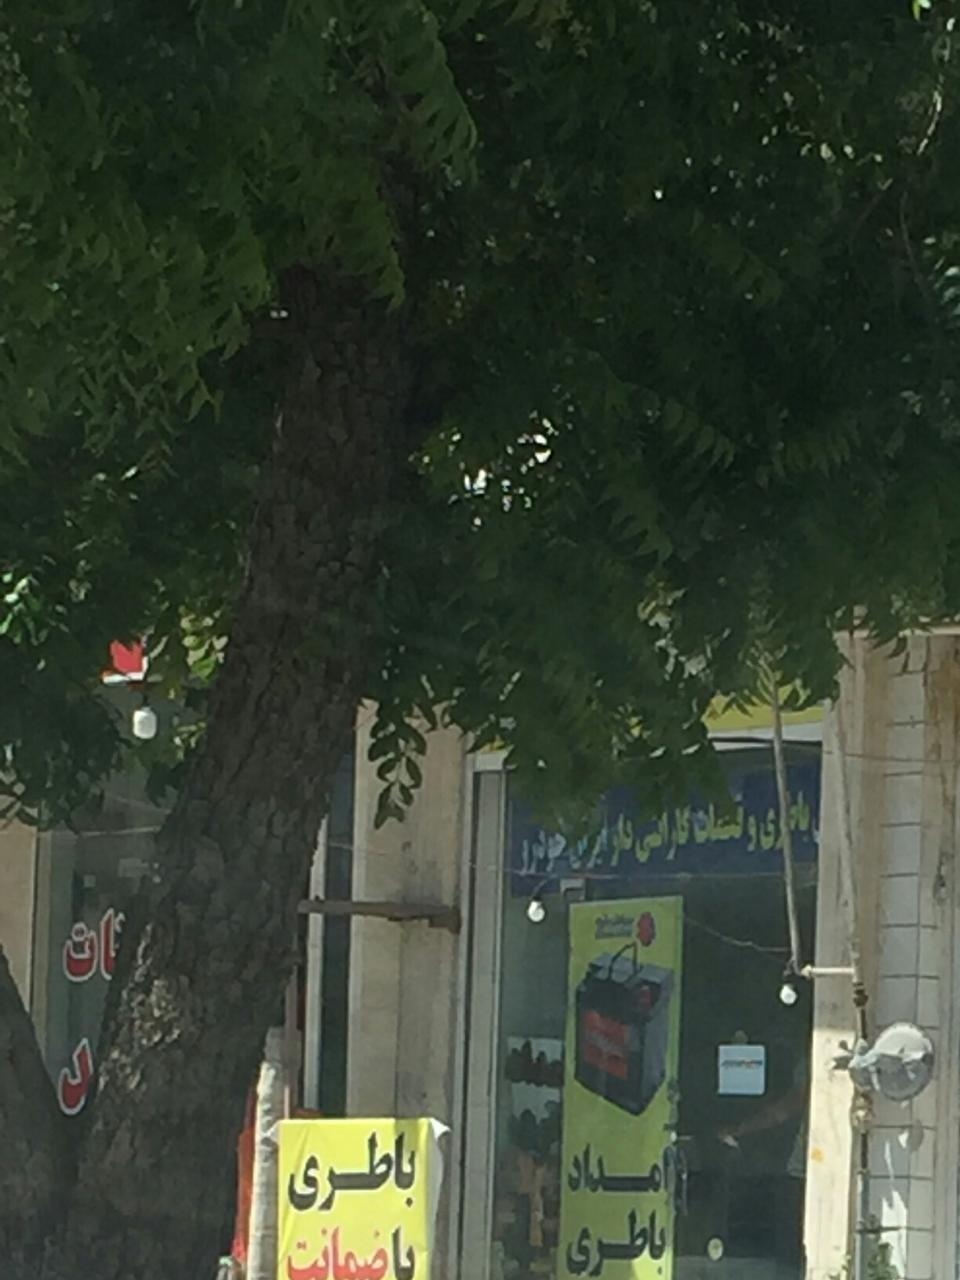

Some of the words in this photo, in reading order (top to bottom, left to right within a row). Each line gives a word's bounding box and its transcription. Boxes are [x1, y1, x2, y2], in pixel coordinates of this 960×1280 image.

[287, 1131, 416, 1211] باطری
[568, 1143, 672, 1193] امداد
[566, 1208, 666, 1277] باطری
